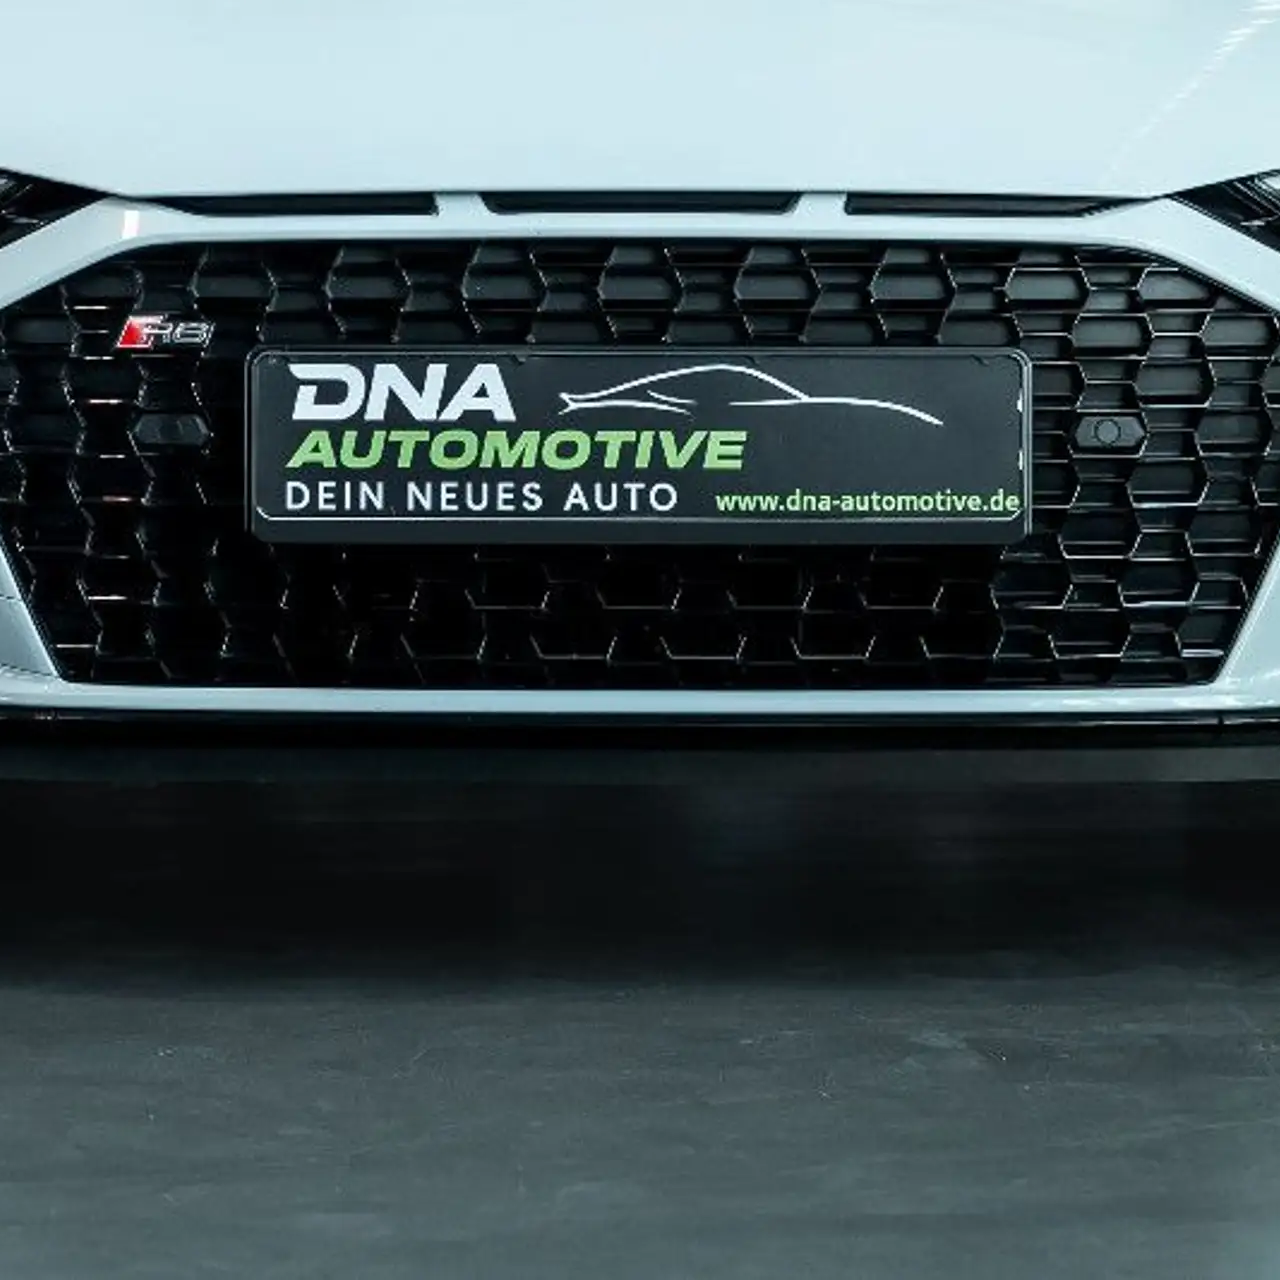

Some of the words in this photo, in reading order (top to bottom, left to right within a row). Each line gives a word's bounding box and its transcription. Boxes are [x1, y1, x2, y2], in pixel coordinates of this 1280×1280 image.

[134, 319, 213, 345] R8
[288, 362, 517, 422] DNA
[284, 429, 748, 471] AUTOMOTIVE
[285, 480, 384, 511] DEIN
[407, 480, 544, 512] NEUES
[563, 480, 679, 512] AUTO
[714, 487, 1020, 513] www.dna-automotive.de
